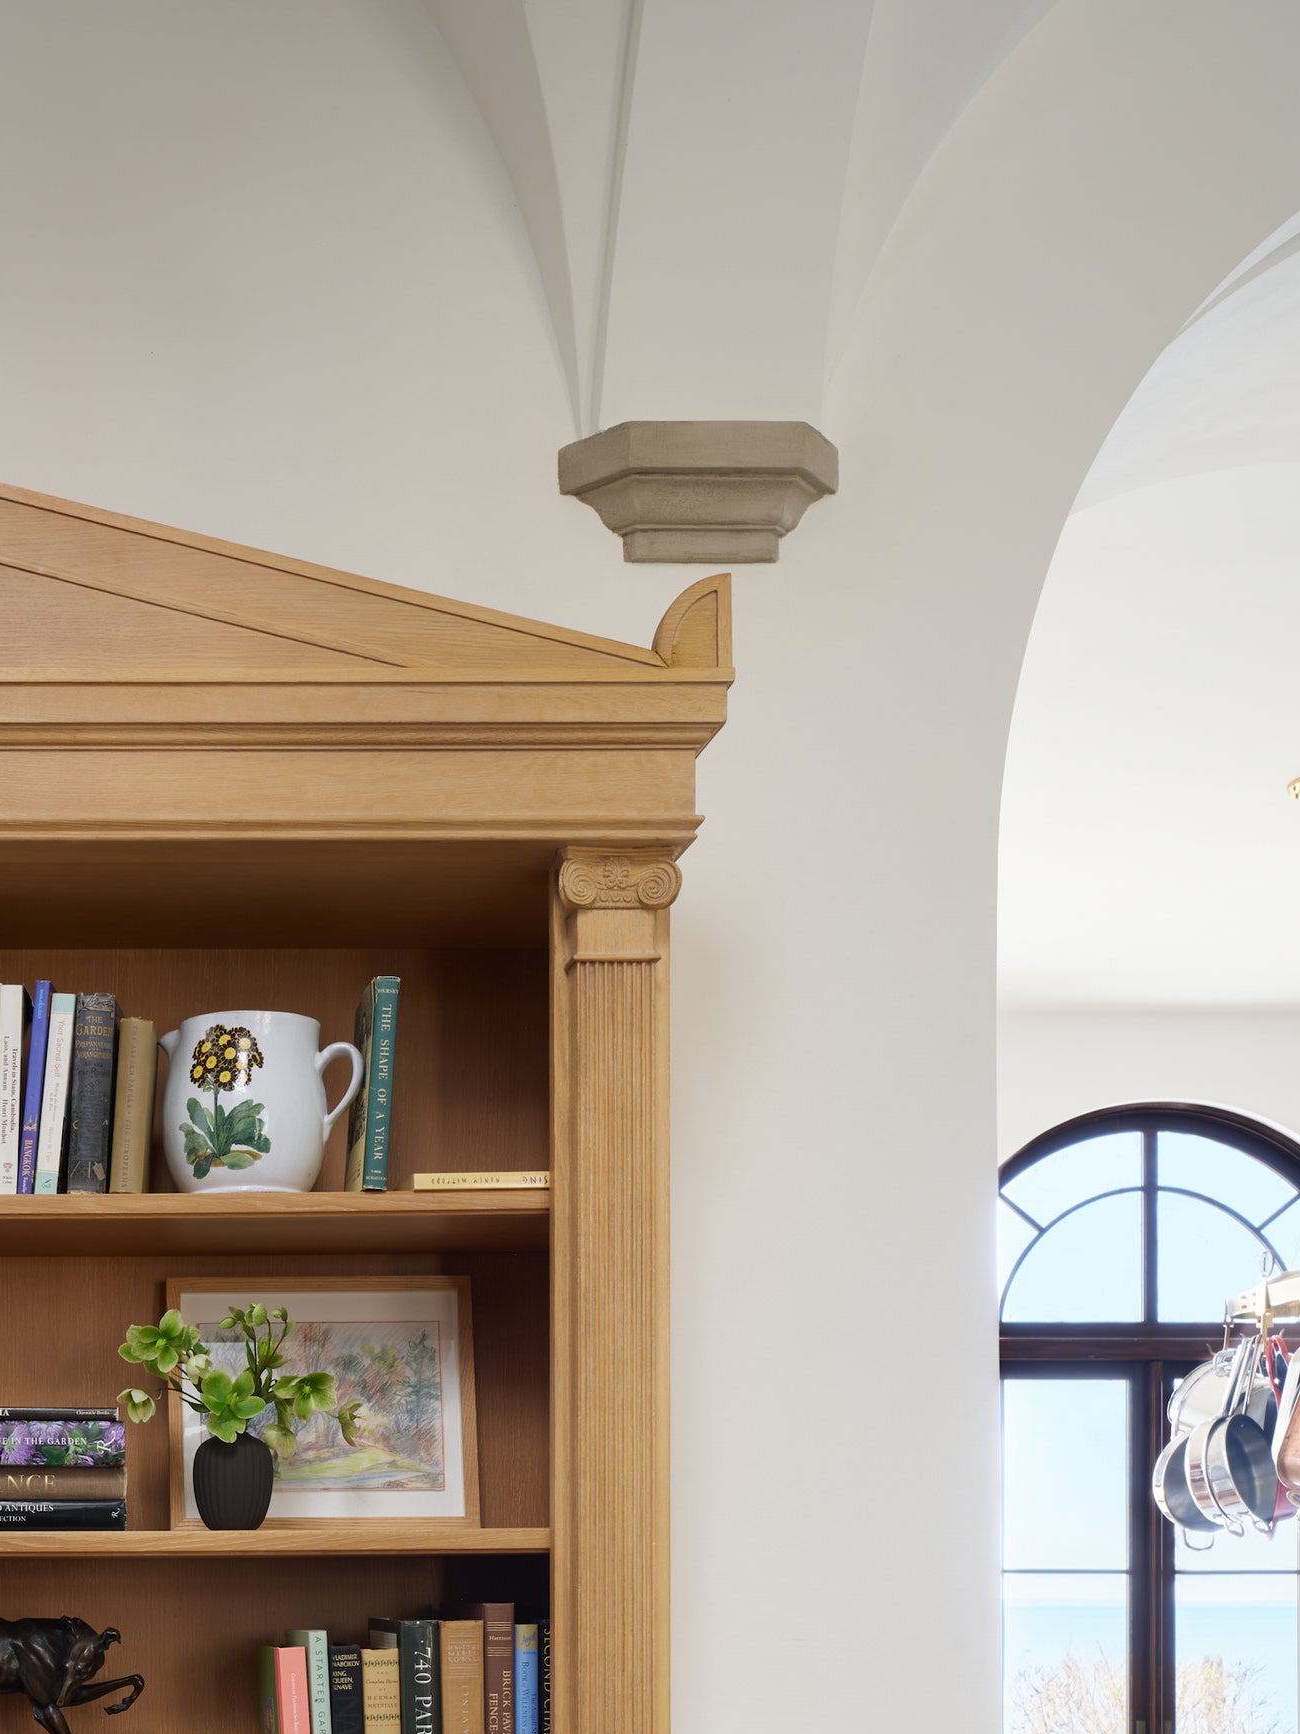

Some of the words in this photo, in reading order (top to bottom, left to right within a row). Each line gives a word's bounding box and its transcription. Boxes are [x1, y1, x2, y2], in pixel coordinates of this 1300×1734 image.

[86, 1015, 104, 1024] THE
[381, 1004, 392, 1032] THE
[57, 1020, 66, 1036] Your
[55, 1038, 64, 1062] Sacred
[379, 1039, 390, 1081] SHAPE
[54, 1064, 62, 1077] Self
[376, 1088, 387, 1106] OF
[375, 1111, 385, 1120] A
[373, 1126, 385, 1161] YEAR
[22, 1139, 33, 1177] BANGKOK
[11, 1437, 22, 1445] IN
[25, 1437, 44, 1445] THE
[47, 1437, 88, 1446] GARDEN
[4, 1504, 55, 1515] ANTIQUES
[331, 1660, 360, 1668] NABOKOV
[332, 1653, 358, 1661] VLADIMIR
[413, 1646, 433, 1685] 740
[315, 1650, 326, 1704] STARTER
[502, 1669, 512, 1708] BRICK
